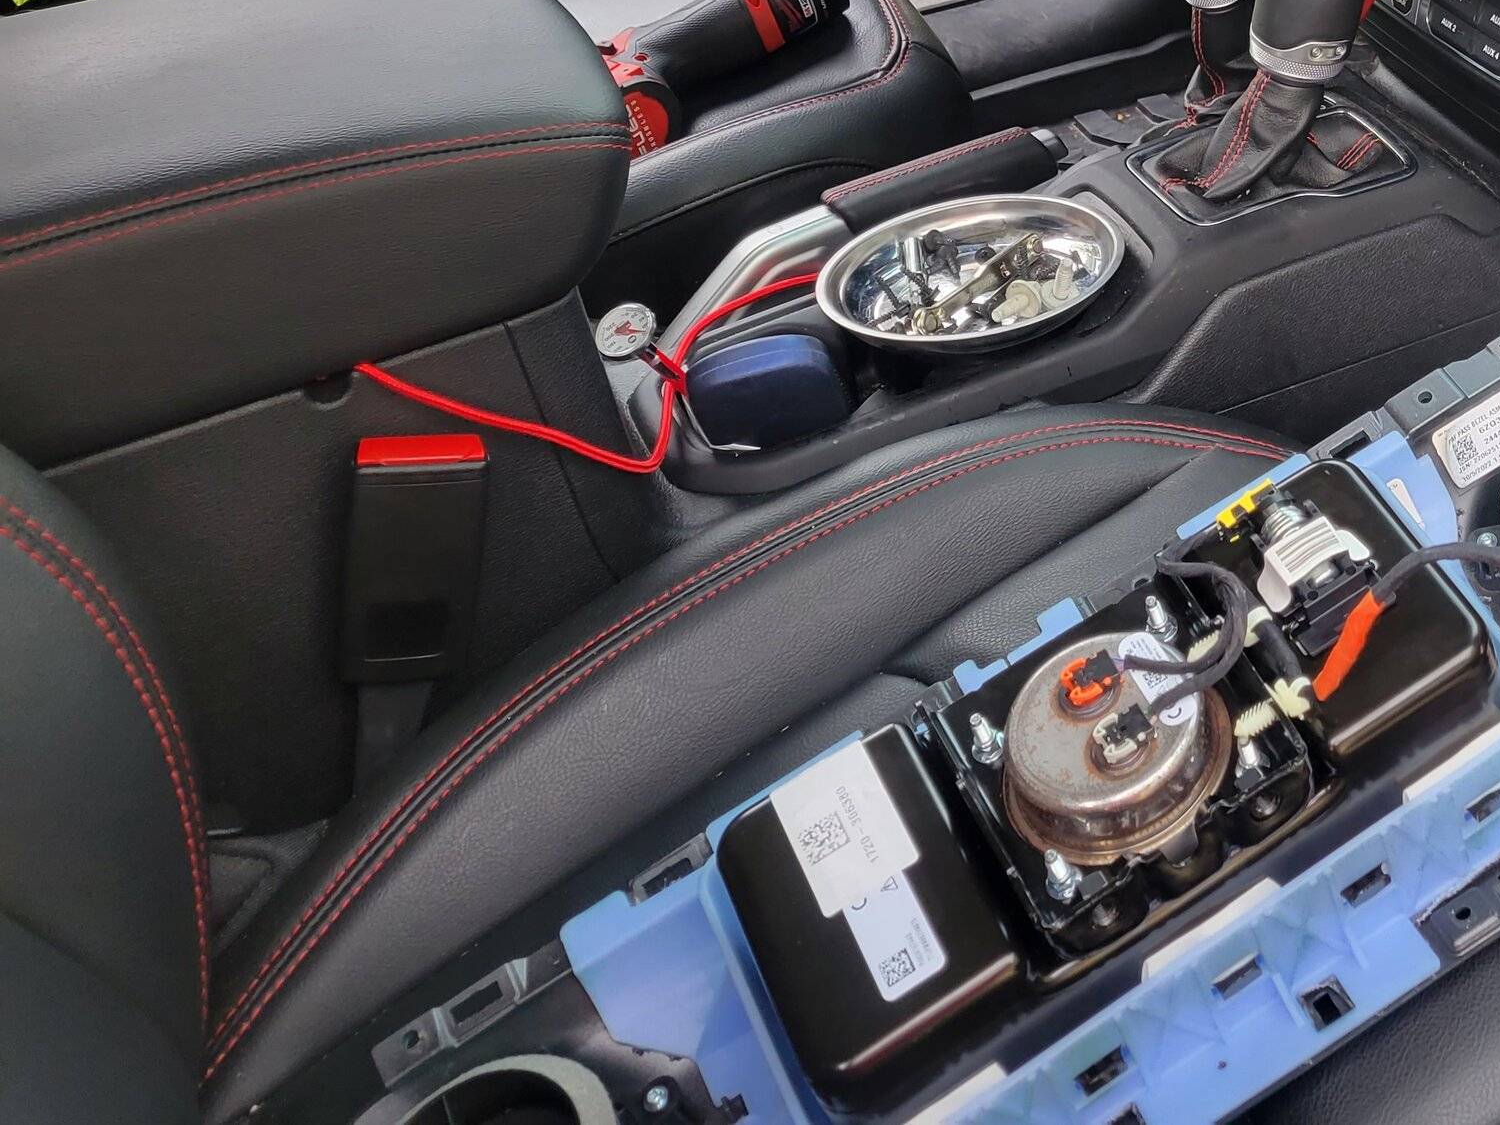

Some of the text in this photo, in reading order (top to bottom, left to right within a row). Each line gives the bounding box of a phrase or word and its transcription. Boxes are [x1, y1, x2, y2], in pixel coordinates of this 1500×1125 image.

[1441, 17, 1457, 33] AUX 2
[1483, 45, 1500, 60] AUX 4
[630, 99, 658, 150] RUSHLESS
